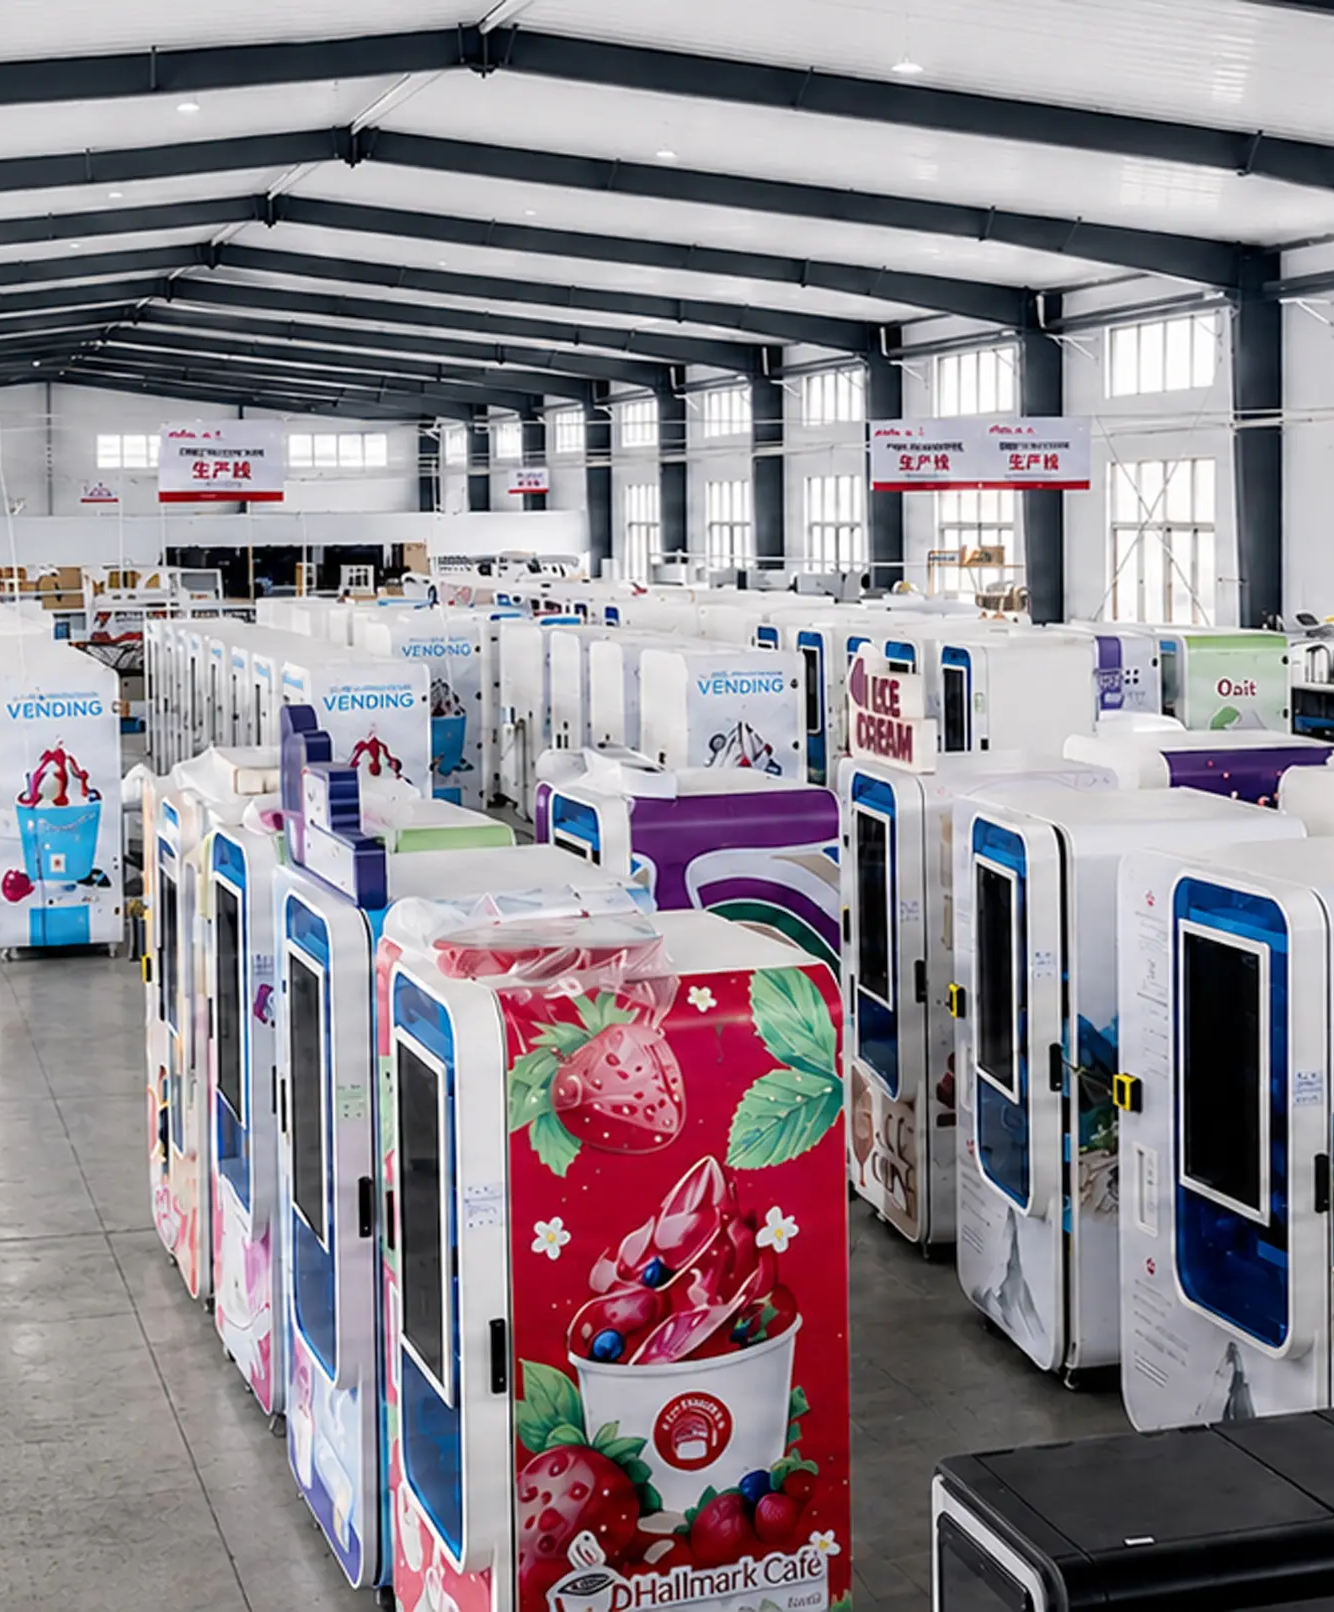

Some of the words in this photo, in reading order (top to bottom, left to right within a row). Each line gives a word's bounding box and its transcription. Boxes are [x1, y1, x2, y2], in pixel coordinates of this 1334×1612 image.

[698, 676, 784, 696] VENDING
[7, 699, 103, 720] VENDING
[323, 690, 415, 712] VENDING
